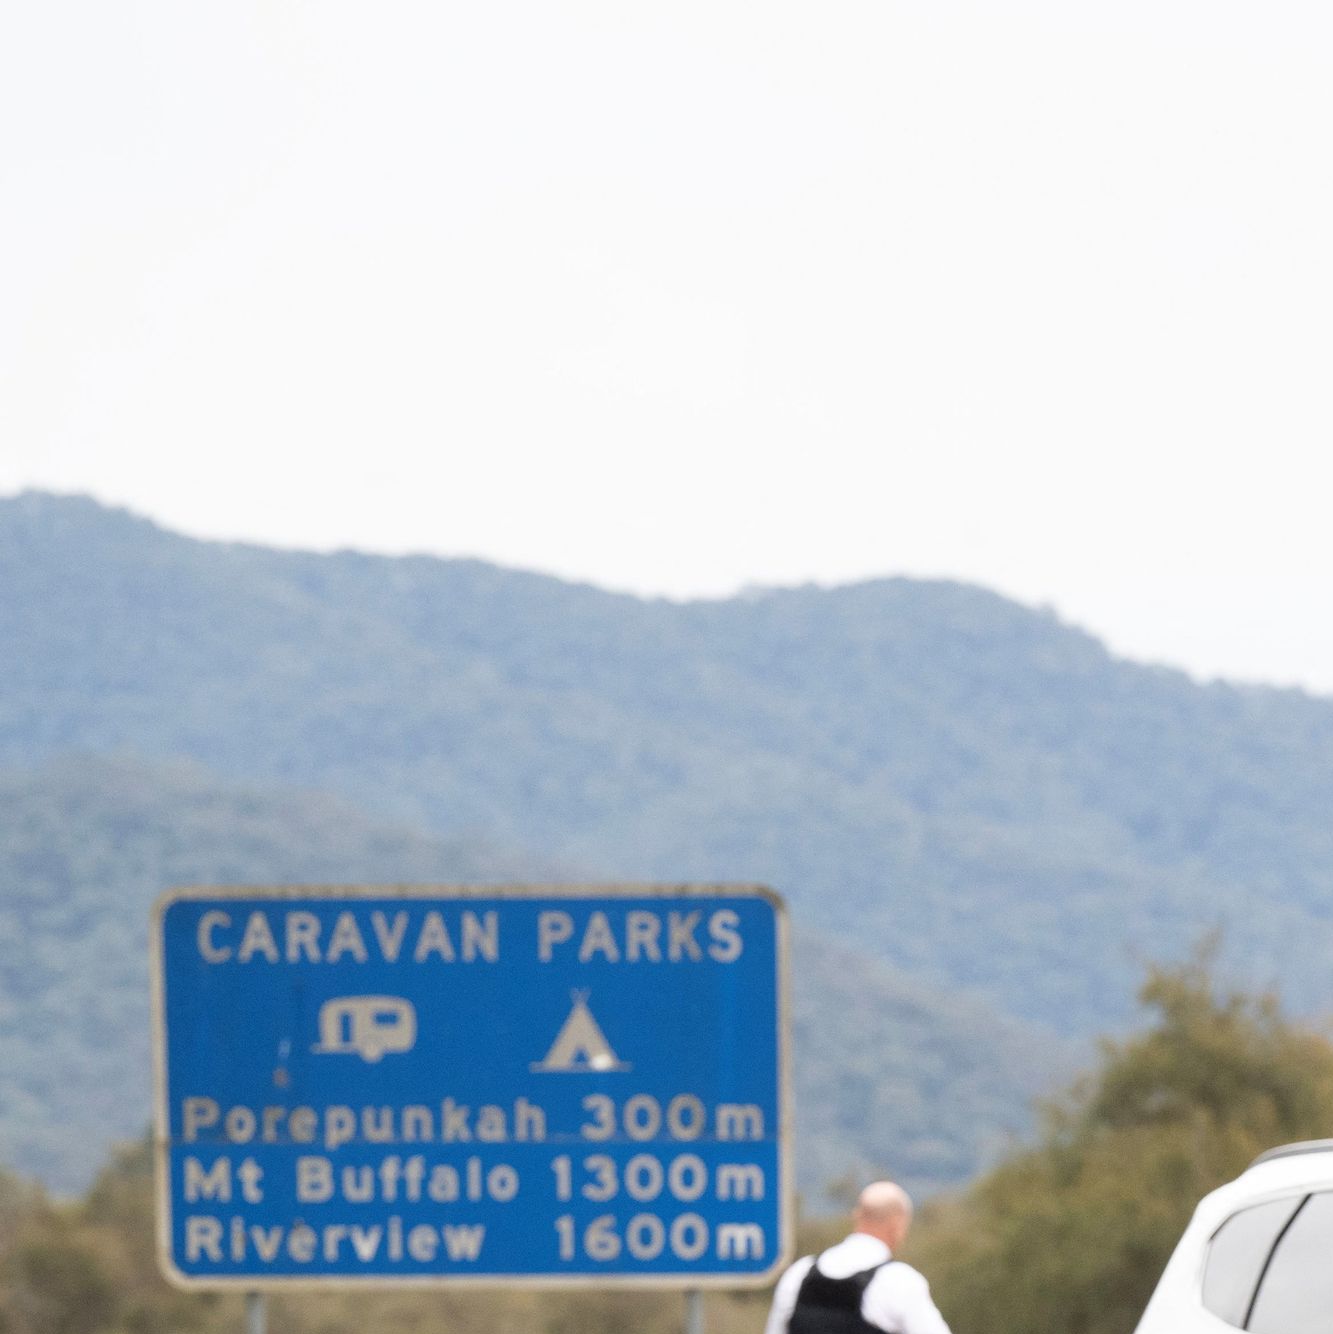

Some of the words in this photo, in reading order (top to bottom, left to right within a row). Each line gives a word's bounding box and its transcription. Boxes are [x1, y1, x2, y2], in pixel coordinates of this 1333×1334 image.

[198, 910, 499, 964] CARAVAN
[537, 909, 743, 963] PARKS
[182, 1096, 546, 1150] Porepunkah
[183, 1155, 264, 1203] Mt
[297, 1155, 519, 1203] Buffalo
[185, 1215, 485, 1262] Riverview
